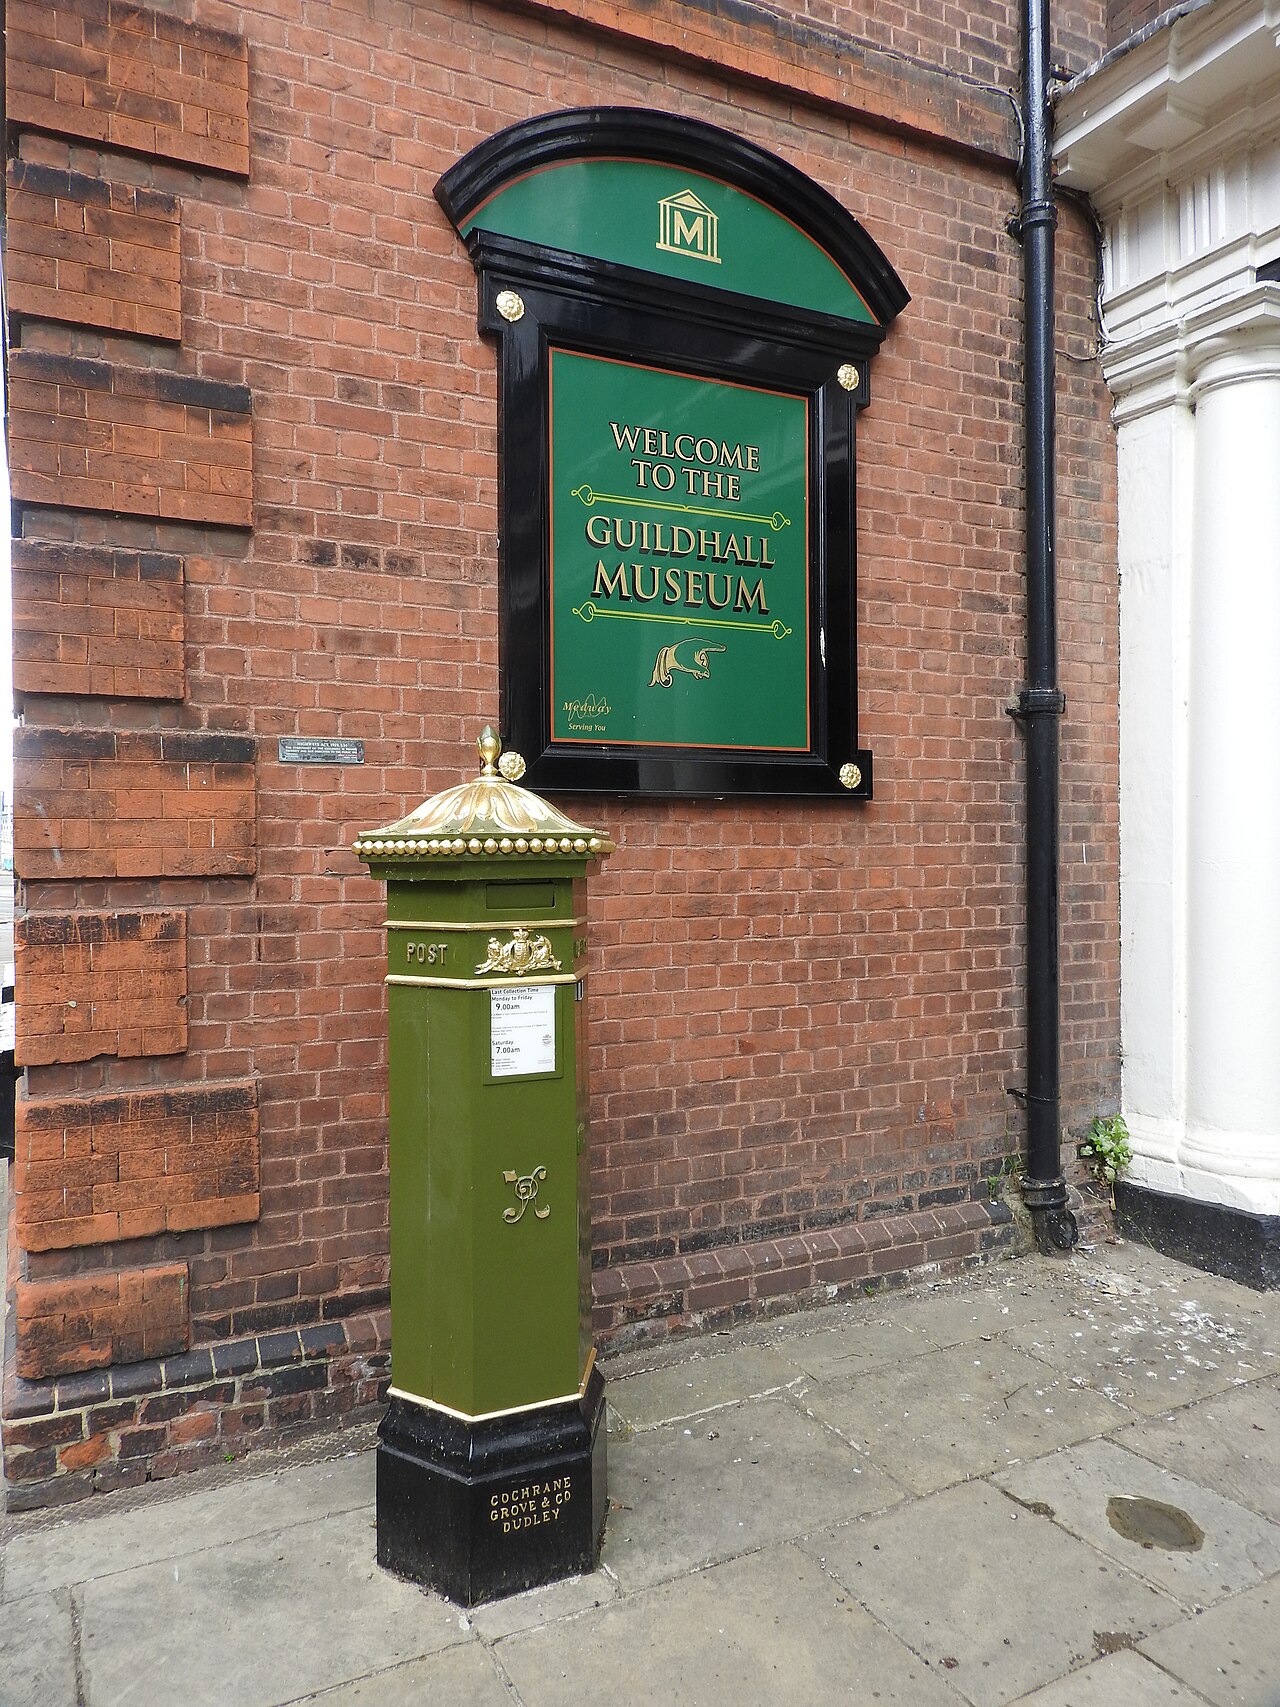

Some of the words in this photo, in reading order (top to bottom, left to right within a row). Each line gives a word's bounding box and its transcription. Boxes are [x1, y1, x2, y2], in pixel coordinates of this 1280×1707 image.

[674, 210, 704, 251] M
[609, 422, 760, 472] WELCOME
[631, 459, 676, 491] TO
[681, 467, 741, 501] THE
[585, 515, 776, 569] GUILDHALL
[591, 559, 771, 615] MUSEUM
[563, 702, 612, 715] Medway
[568, 722, 593, 732] Serving
[594, 724, 606, 732] You
[406, 942, 448, 966] POST
[495, 1046, 520, 1054] 7.00am
[490, 1477, 571, 1507] COCHRANE
[490, 1500, 536, 1521] GROVE
[541, 1496, 550, 1508] &
[555, 1490, 571, 1505] CO
[503, 1508, 560, 1533] DUDLEY
